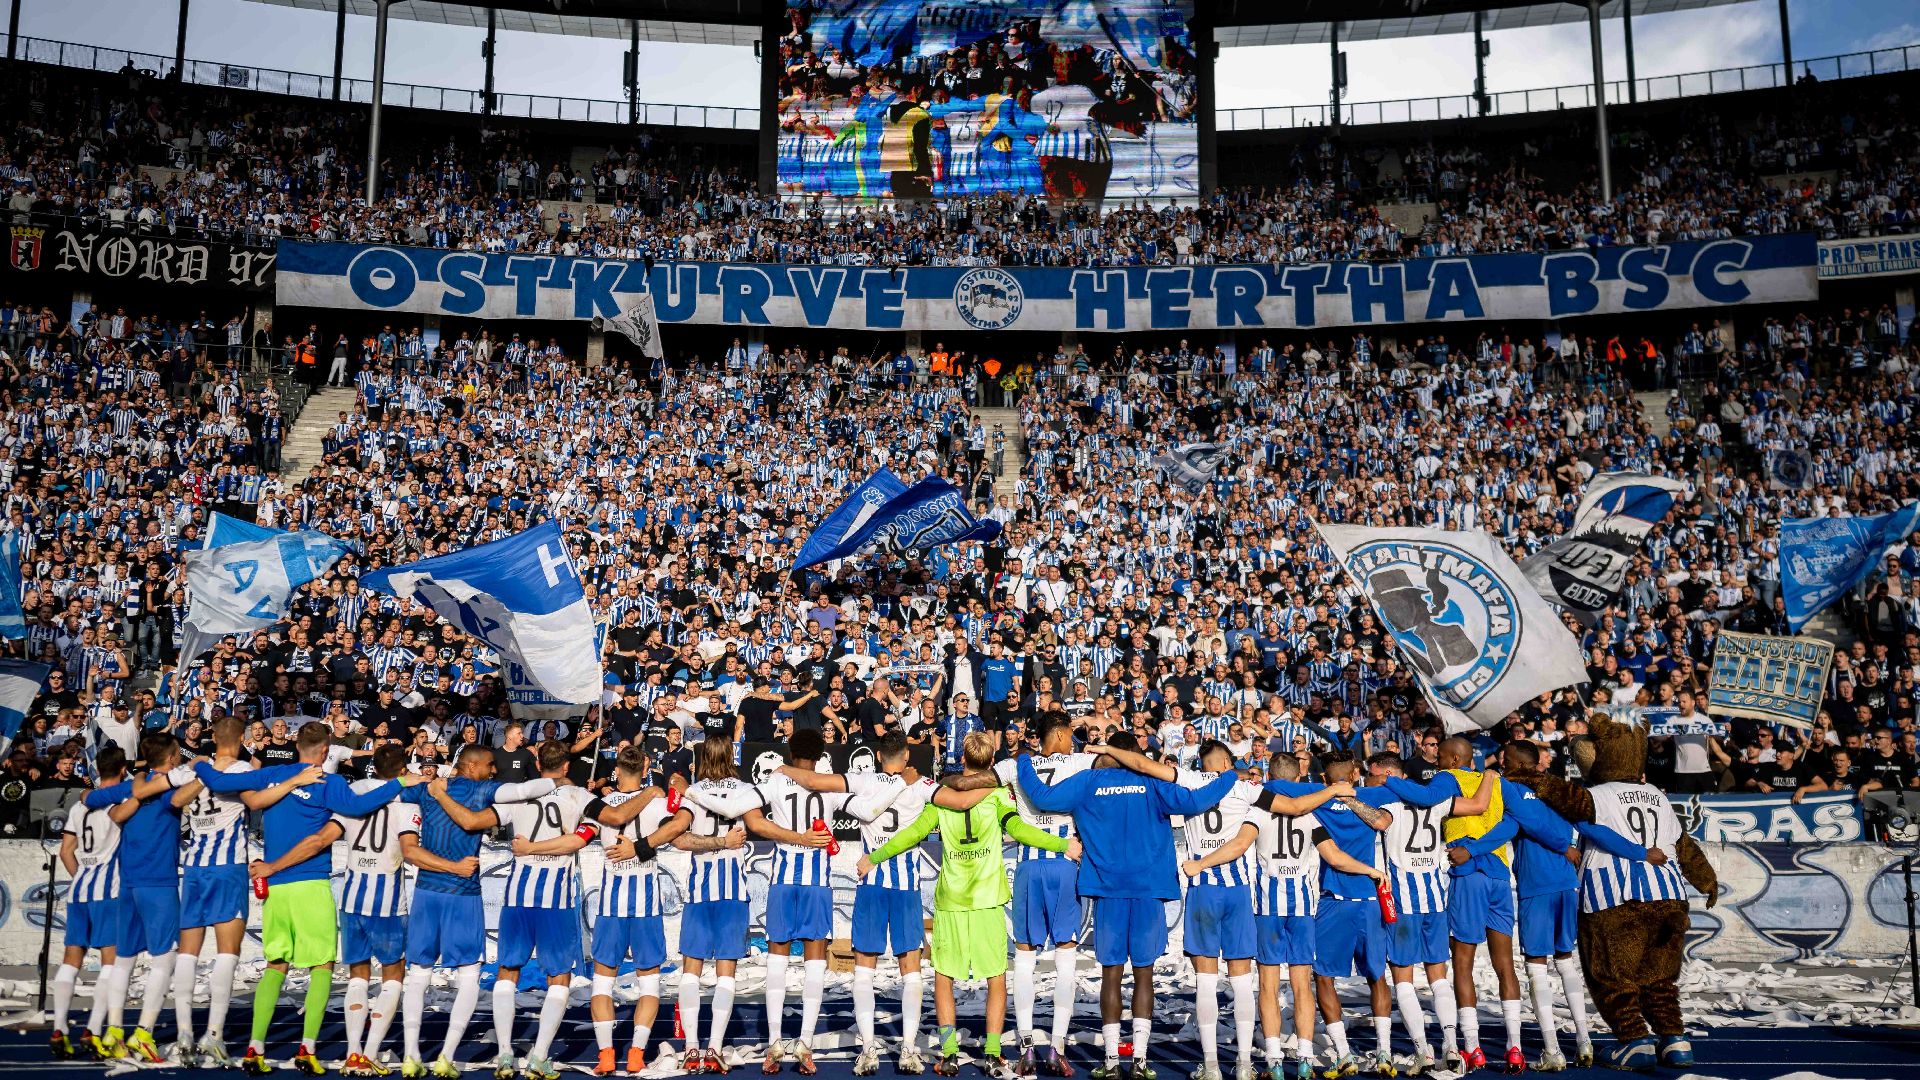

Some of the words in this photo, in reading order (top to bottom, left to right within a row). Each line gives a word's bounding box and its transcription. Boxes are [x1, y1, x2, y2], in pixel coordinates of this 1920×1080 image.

[55, 231, 208, 284] NORD
[1819, 246, 1855, 265] PRO
[1878, 240, 1920, 260] FANS
[1819, 265, 1836, 276] ZUM
[1838, 263, 1865, 275] ERHALT
[1867, 261, 1883, 273] DER
[346, 246, 907, 328] OSTKURVE
[1069, 259, 1485, 330] HERTHA
[1541, 239, 1754, 316] BSC
[961, 271, 1016, 291] OSTKURVE
[960, 305, 1000, 328] HERTHA
[1002, 306, 1019, 326] BSC
[1716, 635, 1830, 667] HAUPTSTADT
[1713, 655, 1824, 703] MAFIA
[1037, 768, 1055, 785] 7
[1095, 785, 1147, 796] AUTOHERO
[352, 806, 389, 853] 20
[785, 792, 824, 835] 10
[959, 808, 979, 845] 1
[1035, 815, 1054, 825] SELKE
[1404, 806, 1437, 853] 23
[1627, 806, 1658, 848] 97
[82, 808, 94, 853] 6
[1271, 813, 1305, 859] 16
[358, 857, 377, 868] KEMPF
[949, 846, 991, 860] CHRISTENSEN
[1278, 865, 1300, 875] KENNY
